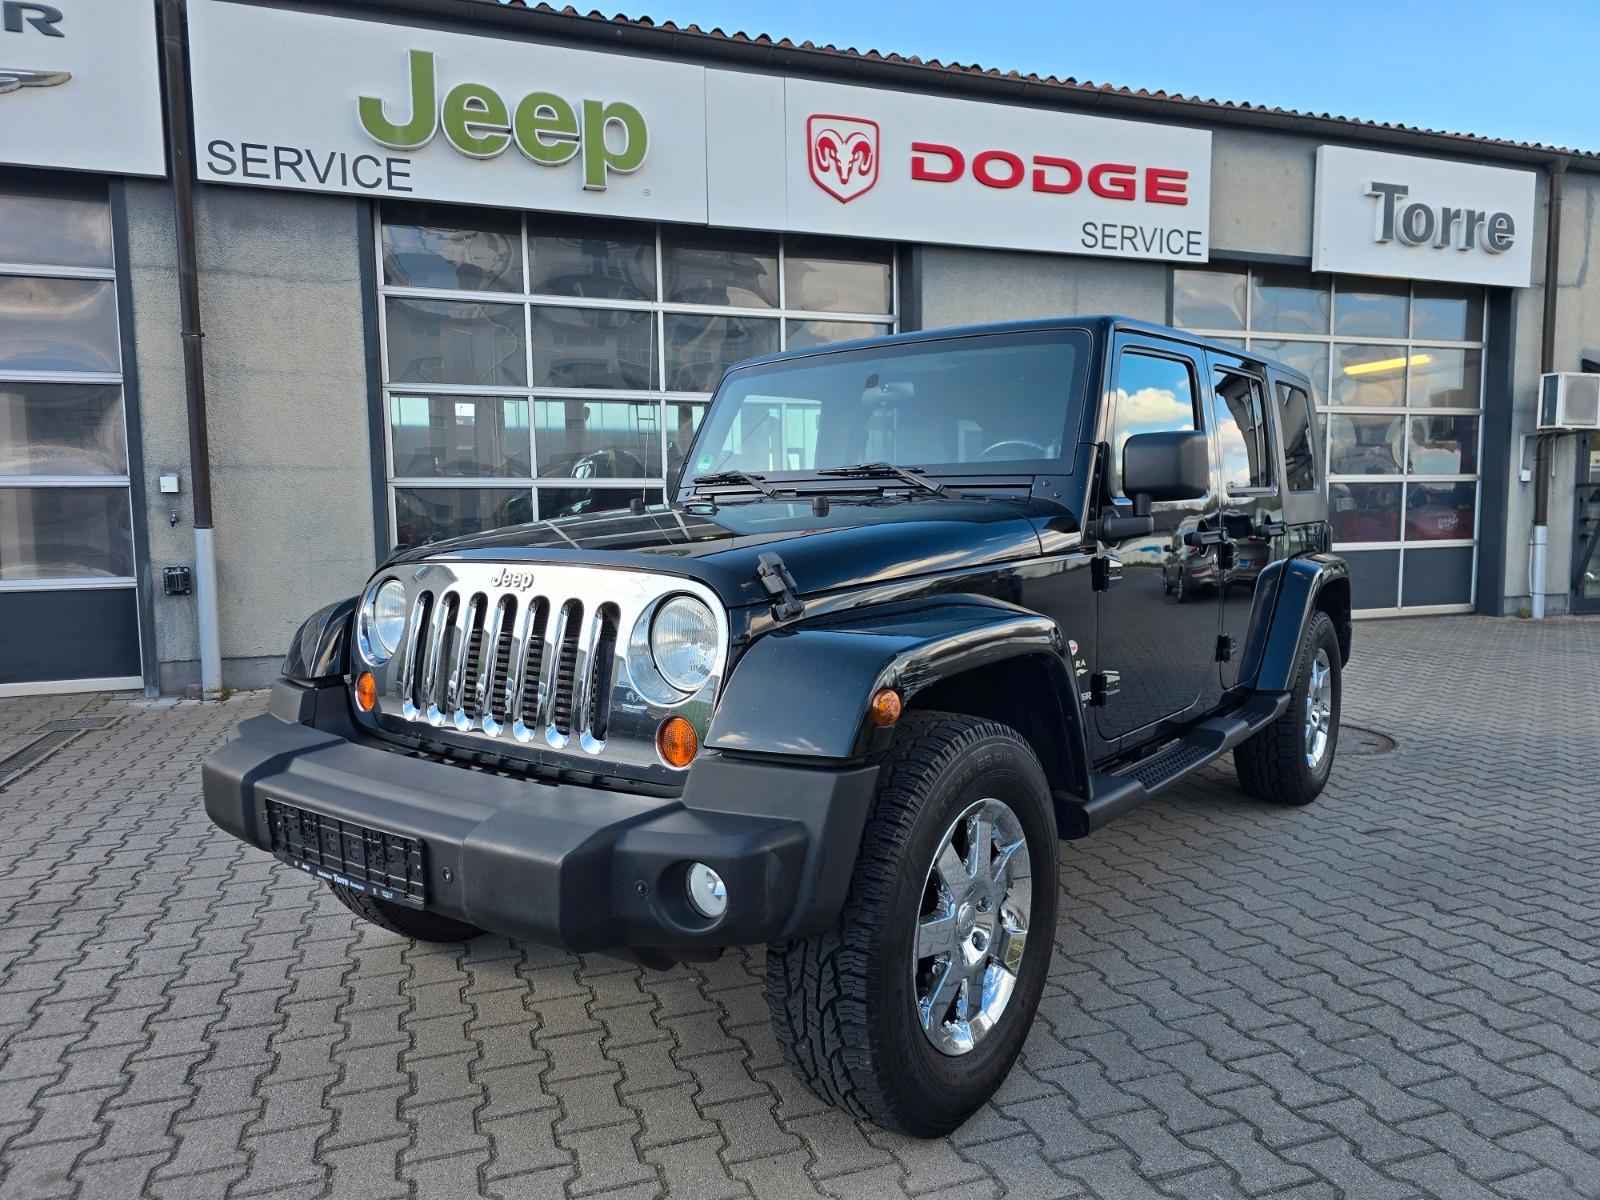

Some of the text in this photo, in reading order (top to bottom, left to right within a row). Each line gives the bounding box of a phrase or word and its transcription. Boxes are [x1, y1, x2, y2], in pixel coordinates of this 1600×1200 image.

[3, 1, 65, 38] R
[359, 50, 648, 191] Jeep
[206, 139, 413, 193] SERVICE
[911, 142, 1189, 206] DODGE
[1081, 222, 1203, 257] SERVICE
[1366, 180, 1516, 254] Torre
[490, 567, 534, 592] Jeep
